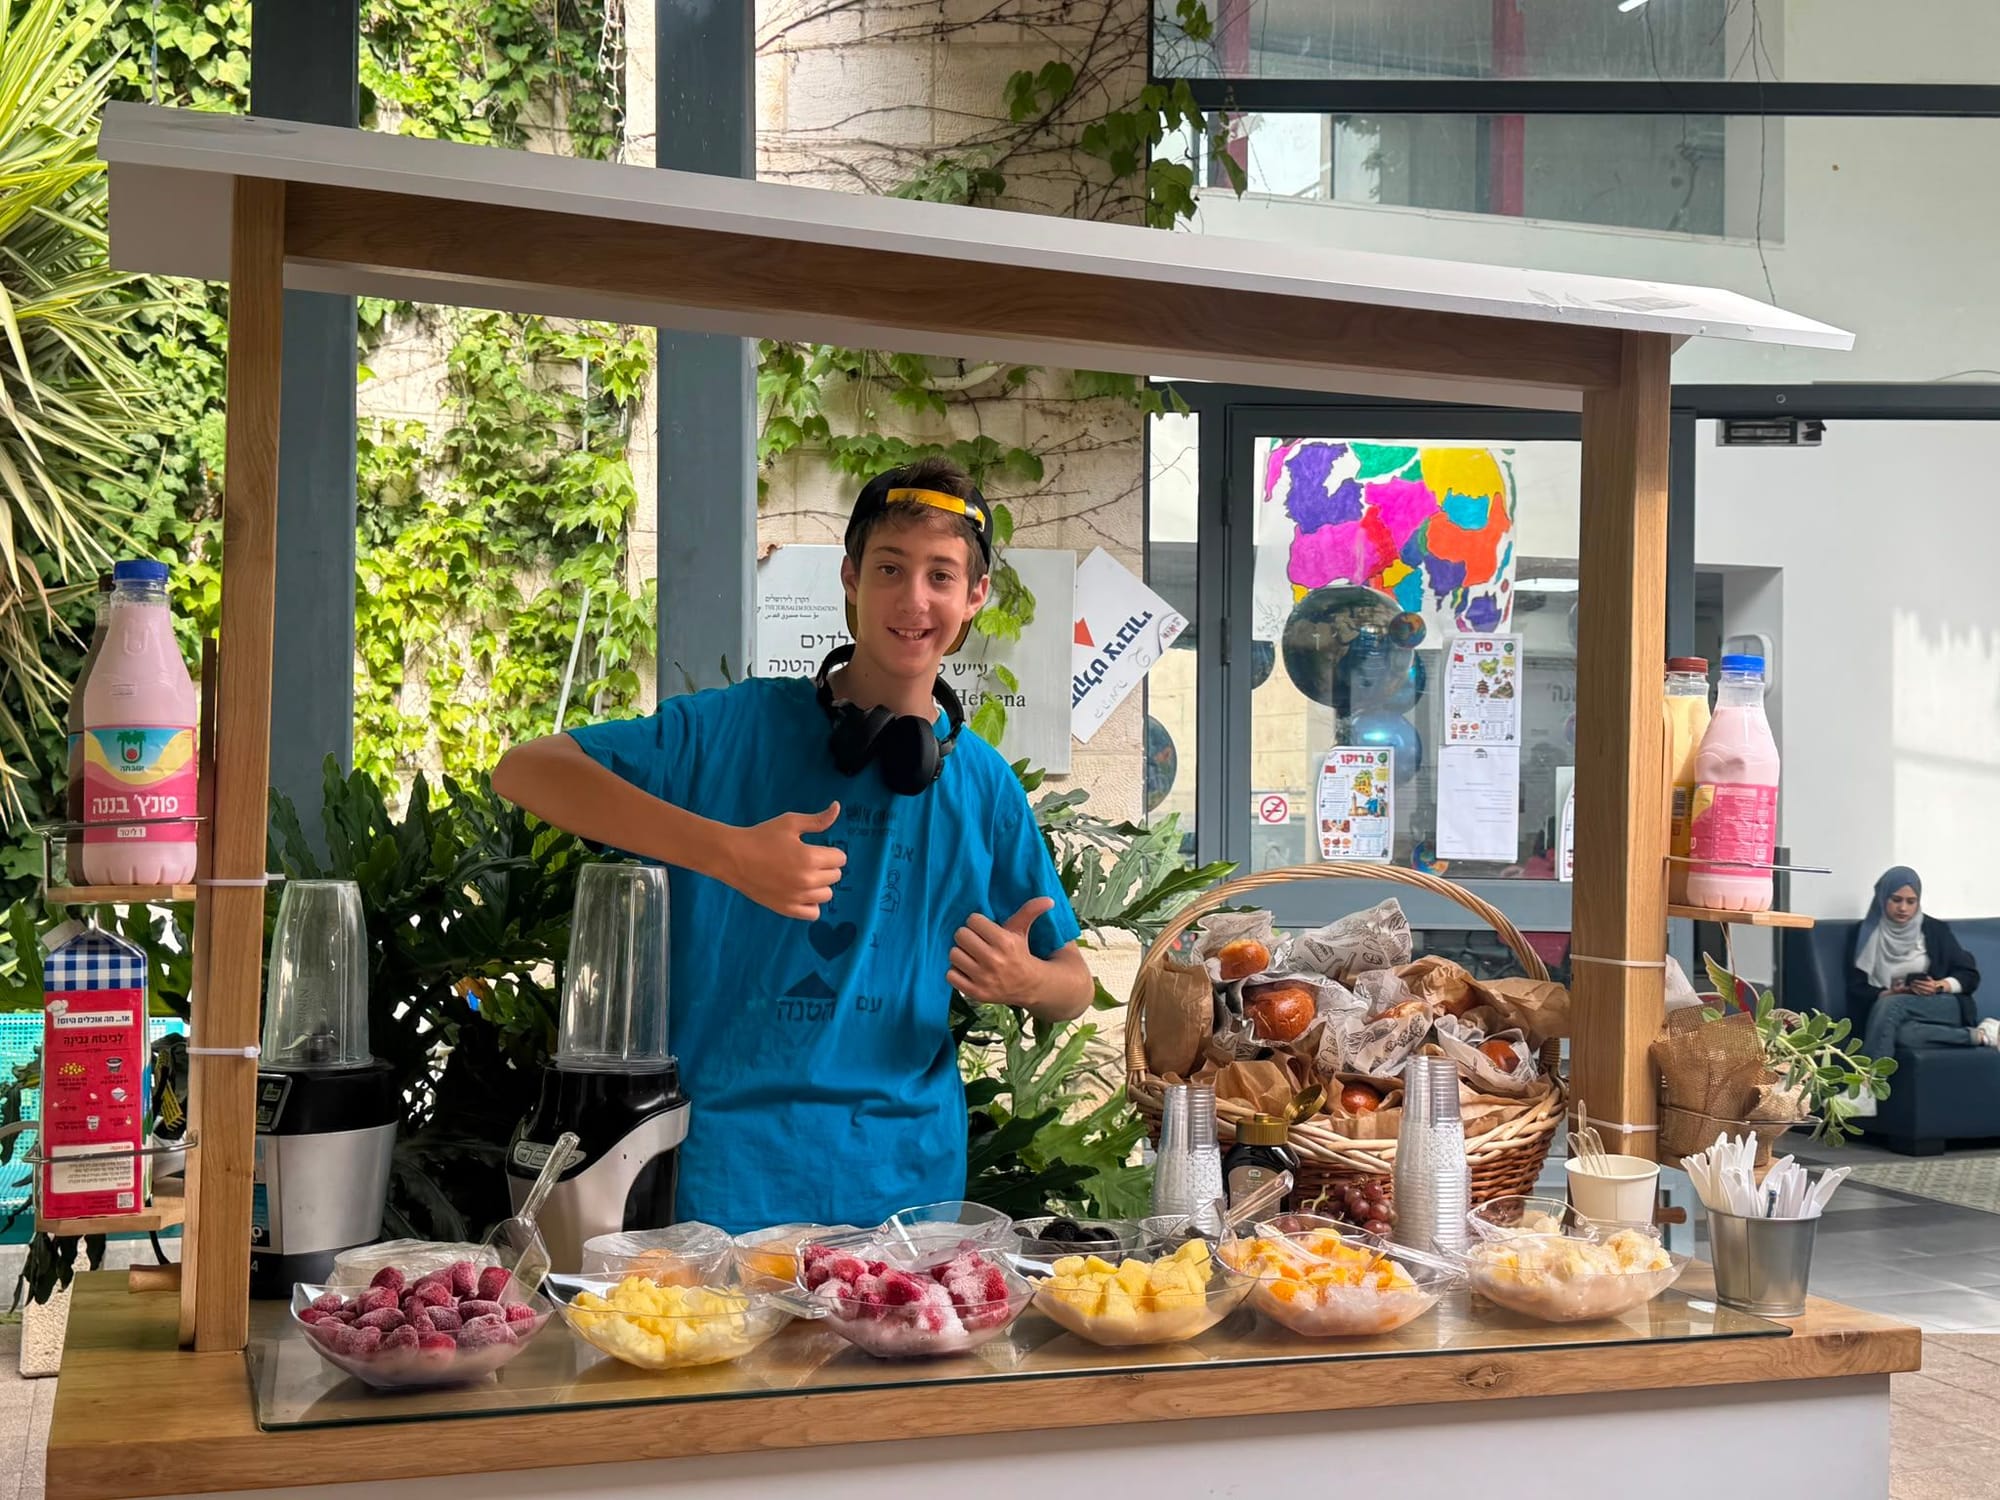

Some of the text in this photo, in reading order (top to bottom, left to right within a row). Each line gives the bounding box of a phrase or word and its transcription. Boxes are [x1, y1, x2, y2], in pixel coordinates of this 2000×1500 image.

[1102, 610, 1154, 662] ציבורי
[769, 659, 815, 673] הטנה
[92, 796, 130, 815] בננה
